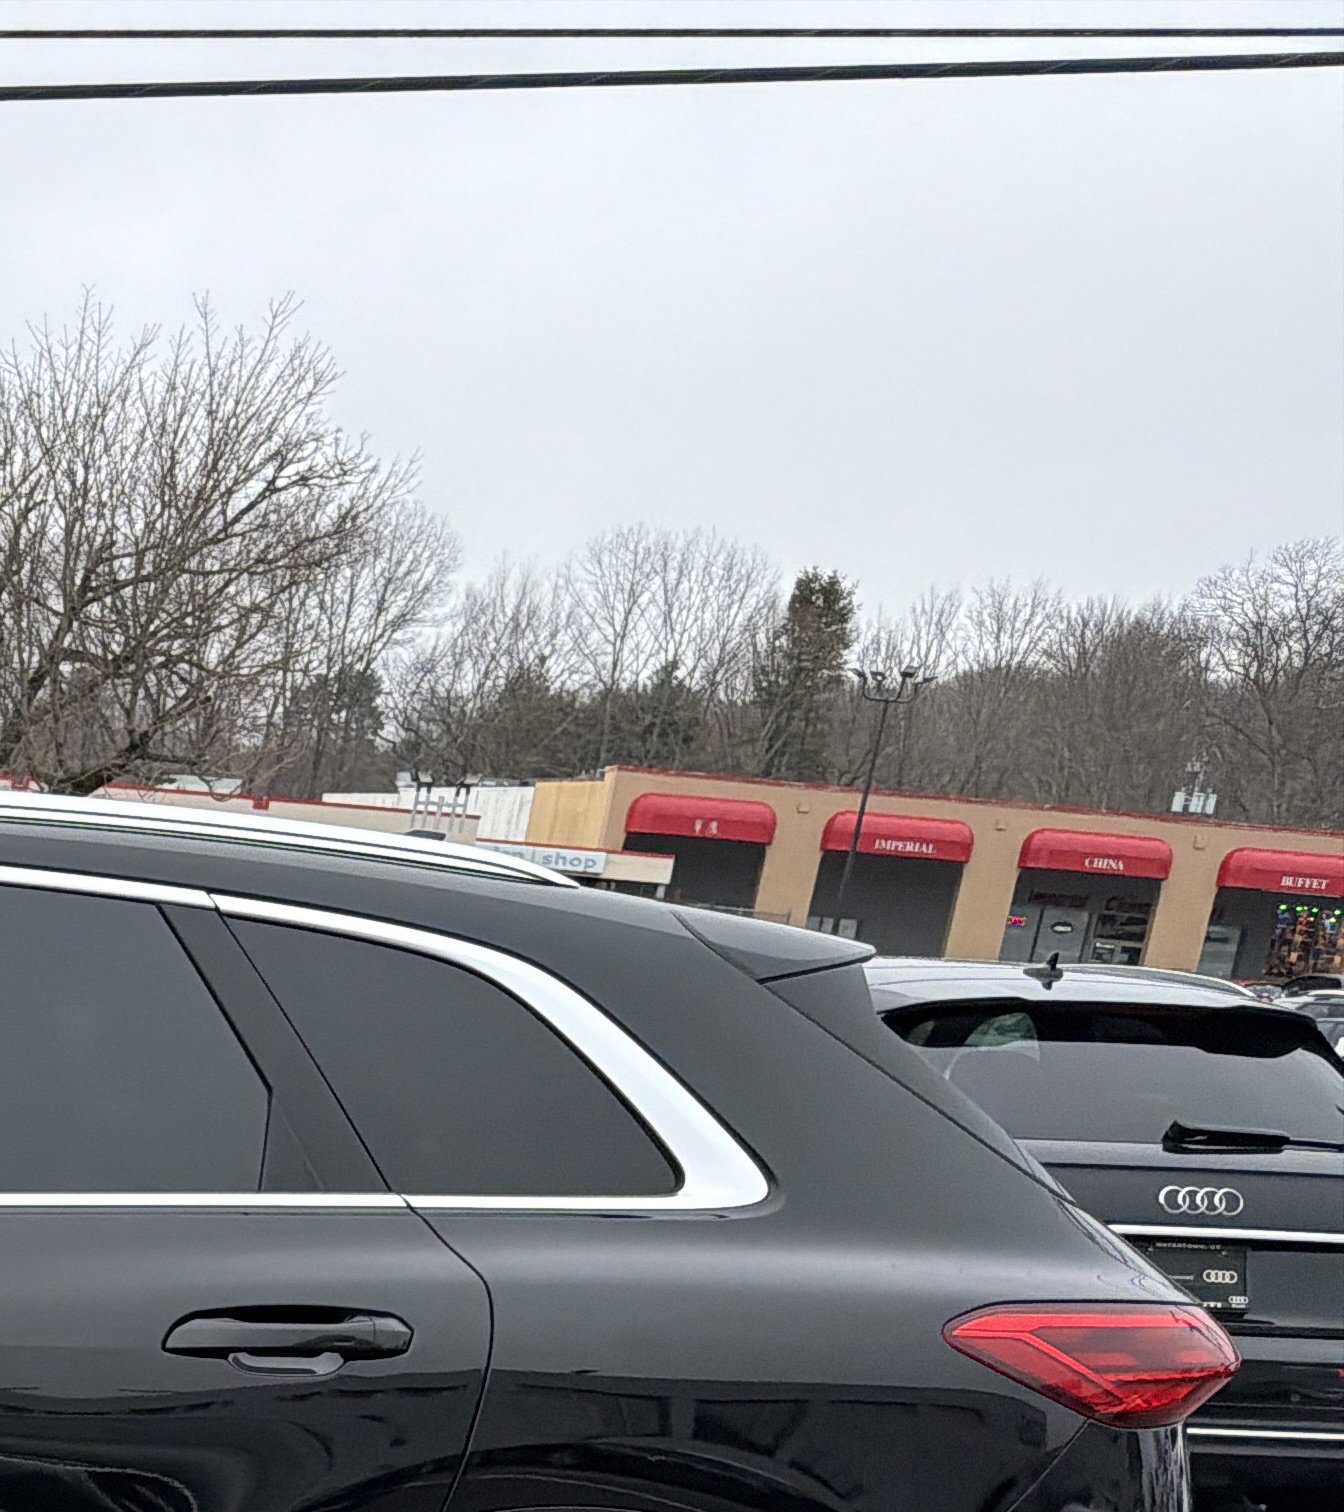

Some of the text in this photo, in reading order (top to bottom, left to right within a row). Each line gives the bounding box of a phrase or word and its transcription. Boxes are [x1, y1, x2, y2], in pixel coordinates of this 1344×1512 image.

[874, 839, 936, 854] IMPERIAL
[542, 852, 597, 869] shop
[1084, 857, 1124, 871] CHINA
[1281, 876, 1330, 889] BUFFET
